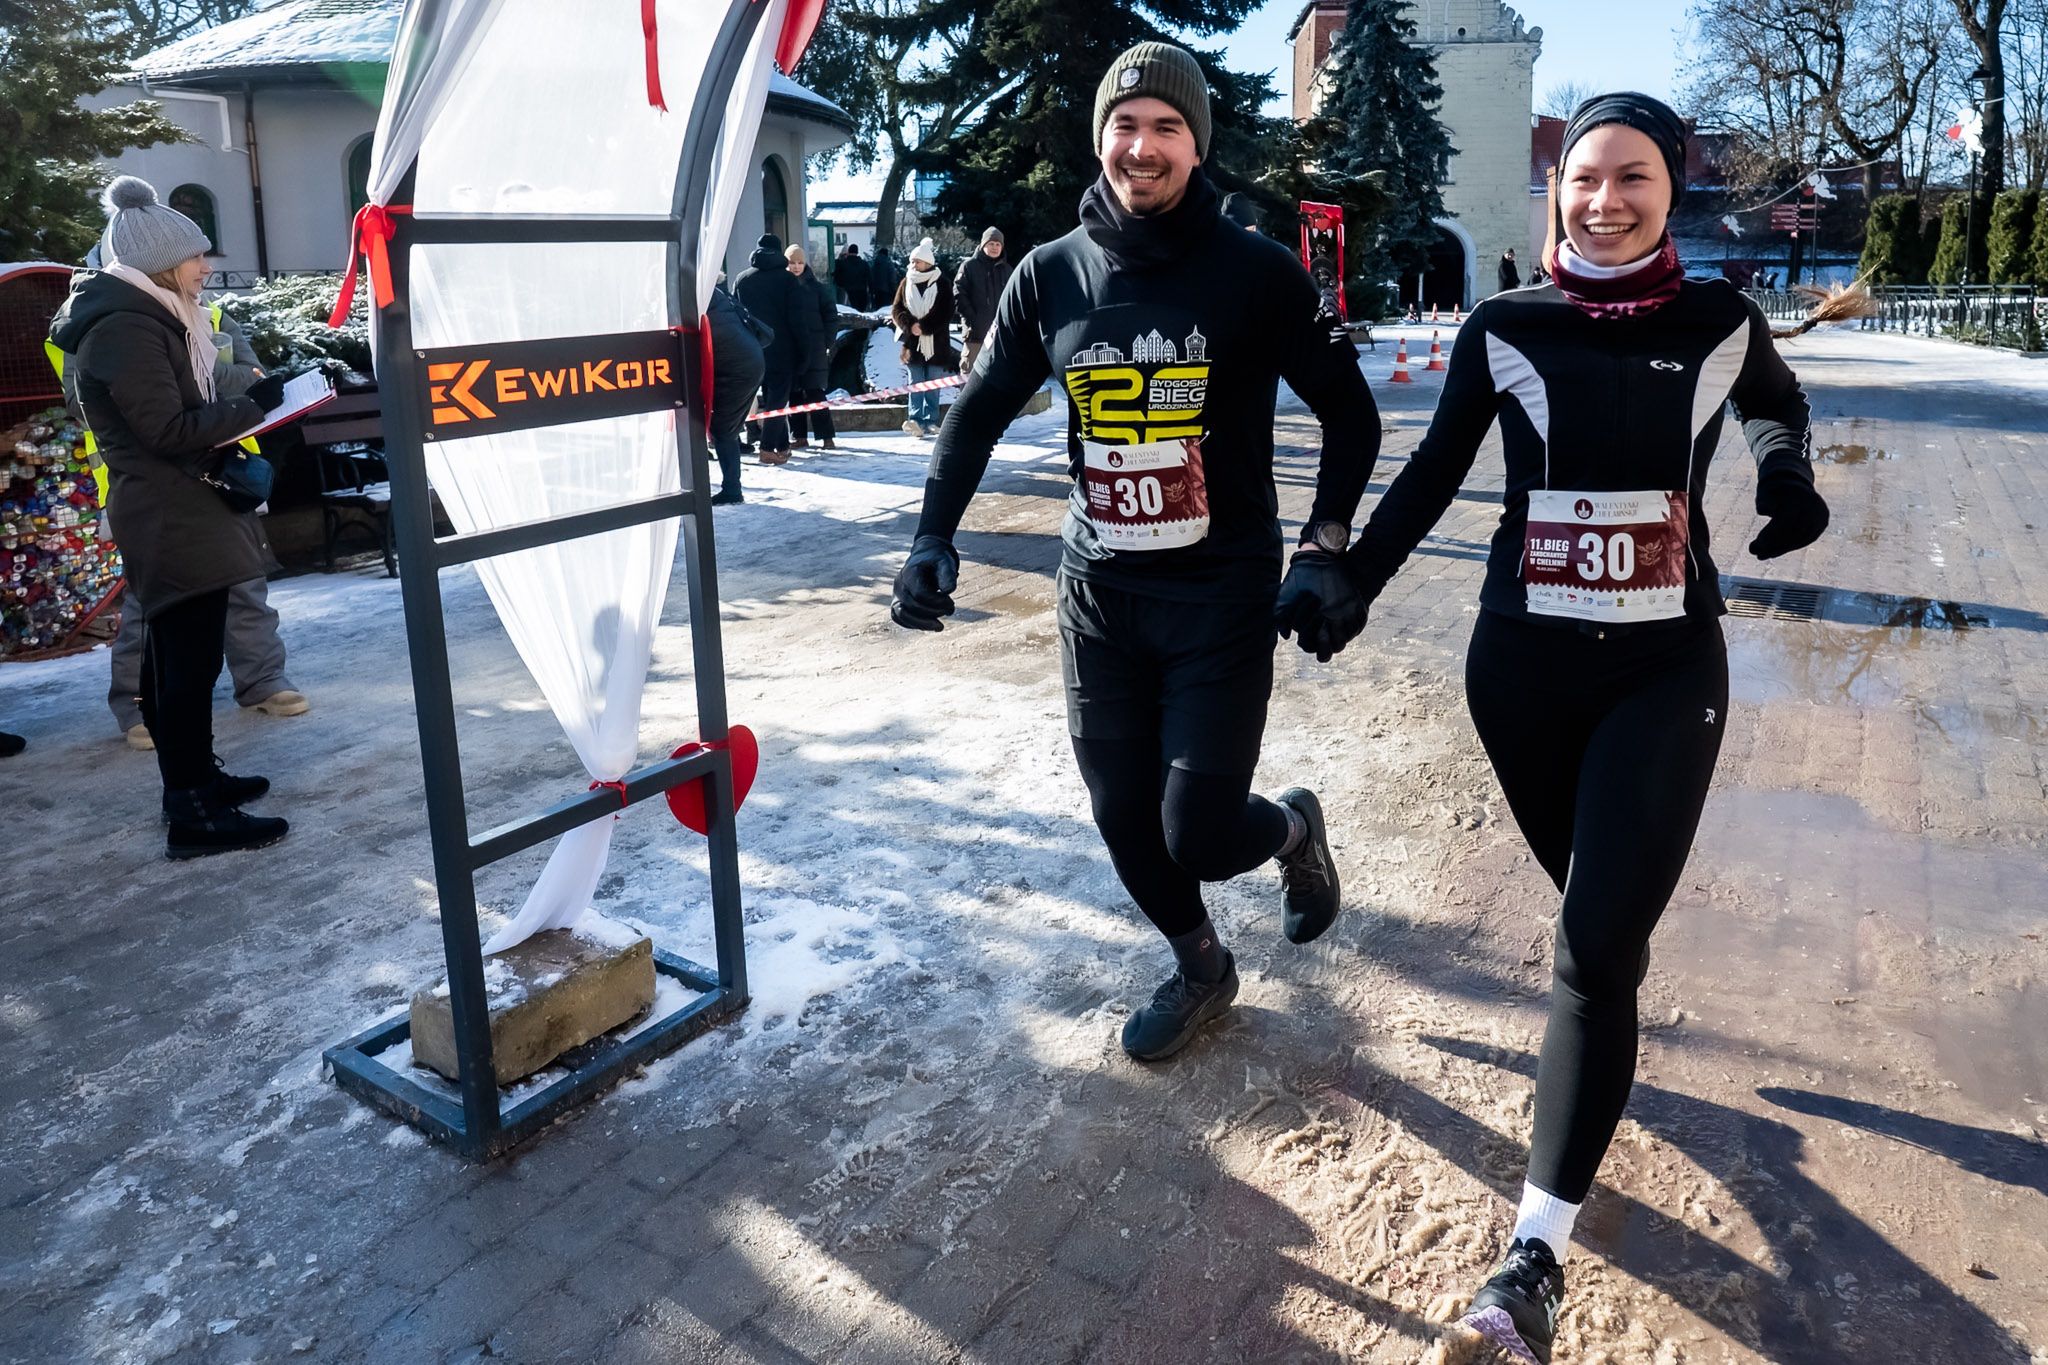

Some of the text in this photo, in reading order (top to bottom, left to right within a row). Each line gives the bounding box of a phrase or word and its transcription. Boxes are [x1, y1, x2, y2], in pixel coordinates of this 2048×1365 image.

[1149, 379, 1208, 388] BYDGOSKI
[1148, 387, 1206, 403] BIEG
[1148, 402, 1204, 410] URODZINOWY
[1115, 476, 1163, 517] 30
[1577, 532, 1635, 581] 30
